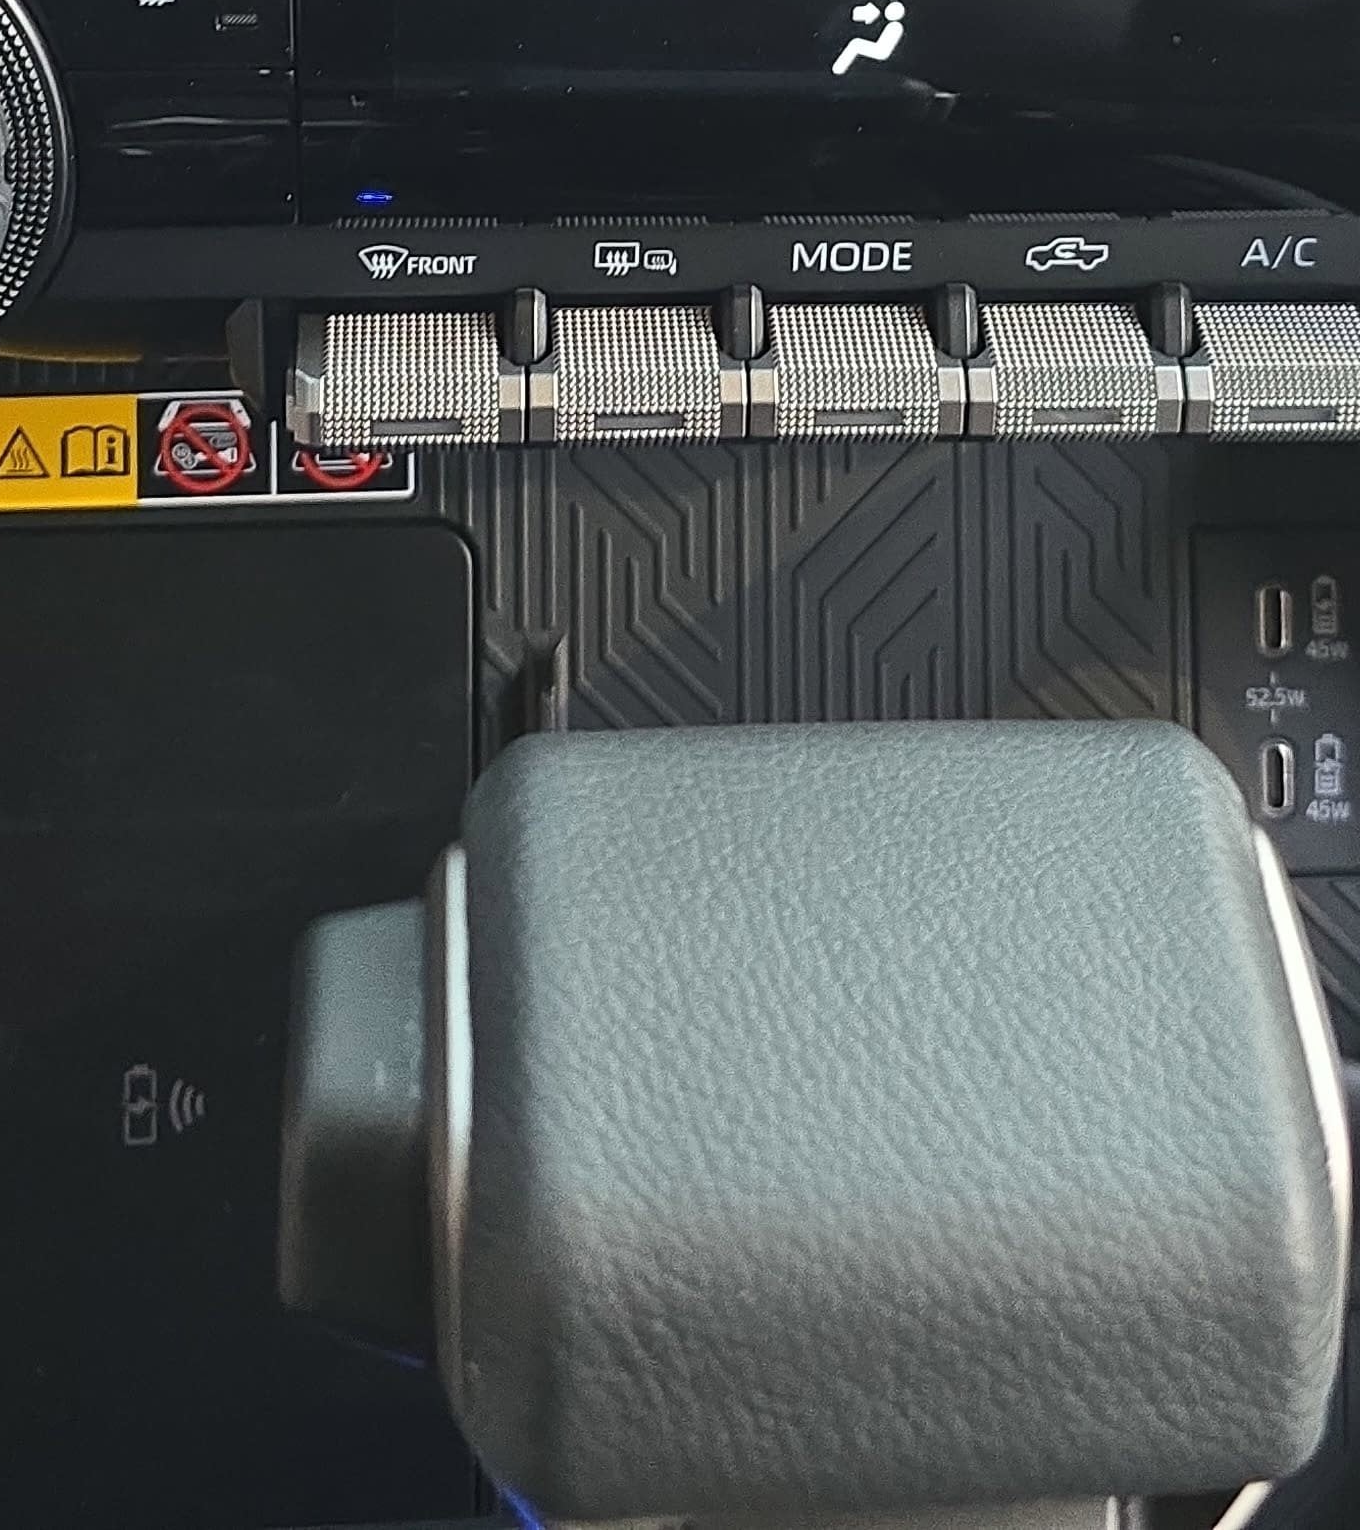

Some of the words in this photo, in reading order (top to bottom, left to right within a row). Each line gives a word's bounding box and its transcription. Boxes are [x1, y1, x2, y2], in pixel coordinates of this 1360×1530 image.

[407, 254, 478, 275] FRONT
[791, 241, 914, 272] MODE
[1241, 238, 1318, 269] A/C
[1305, 801, 1352, 823] 45W
